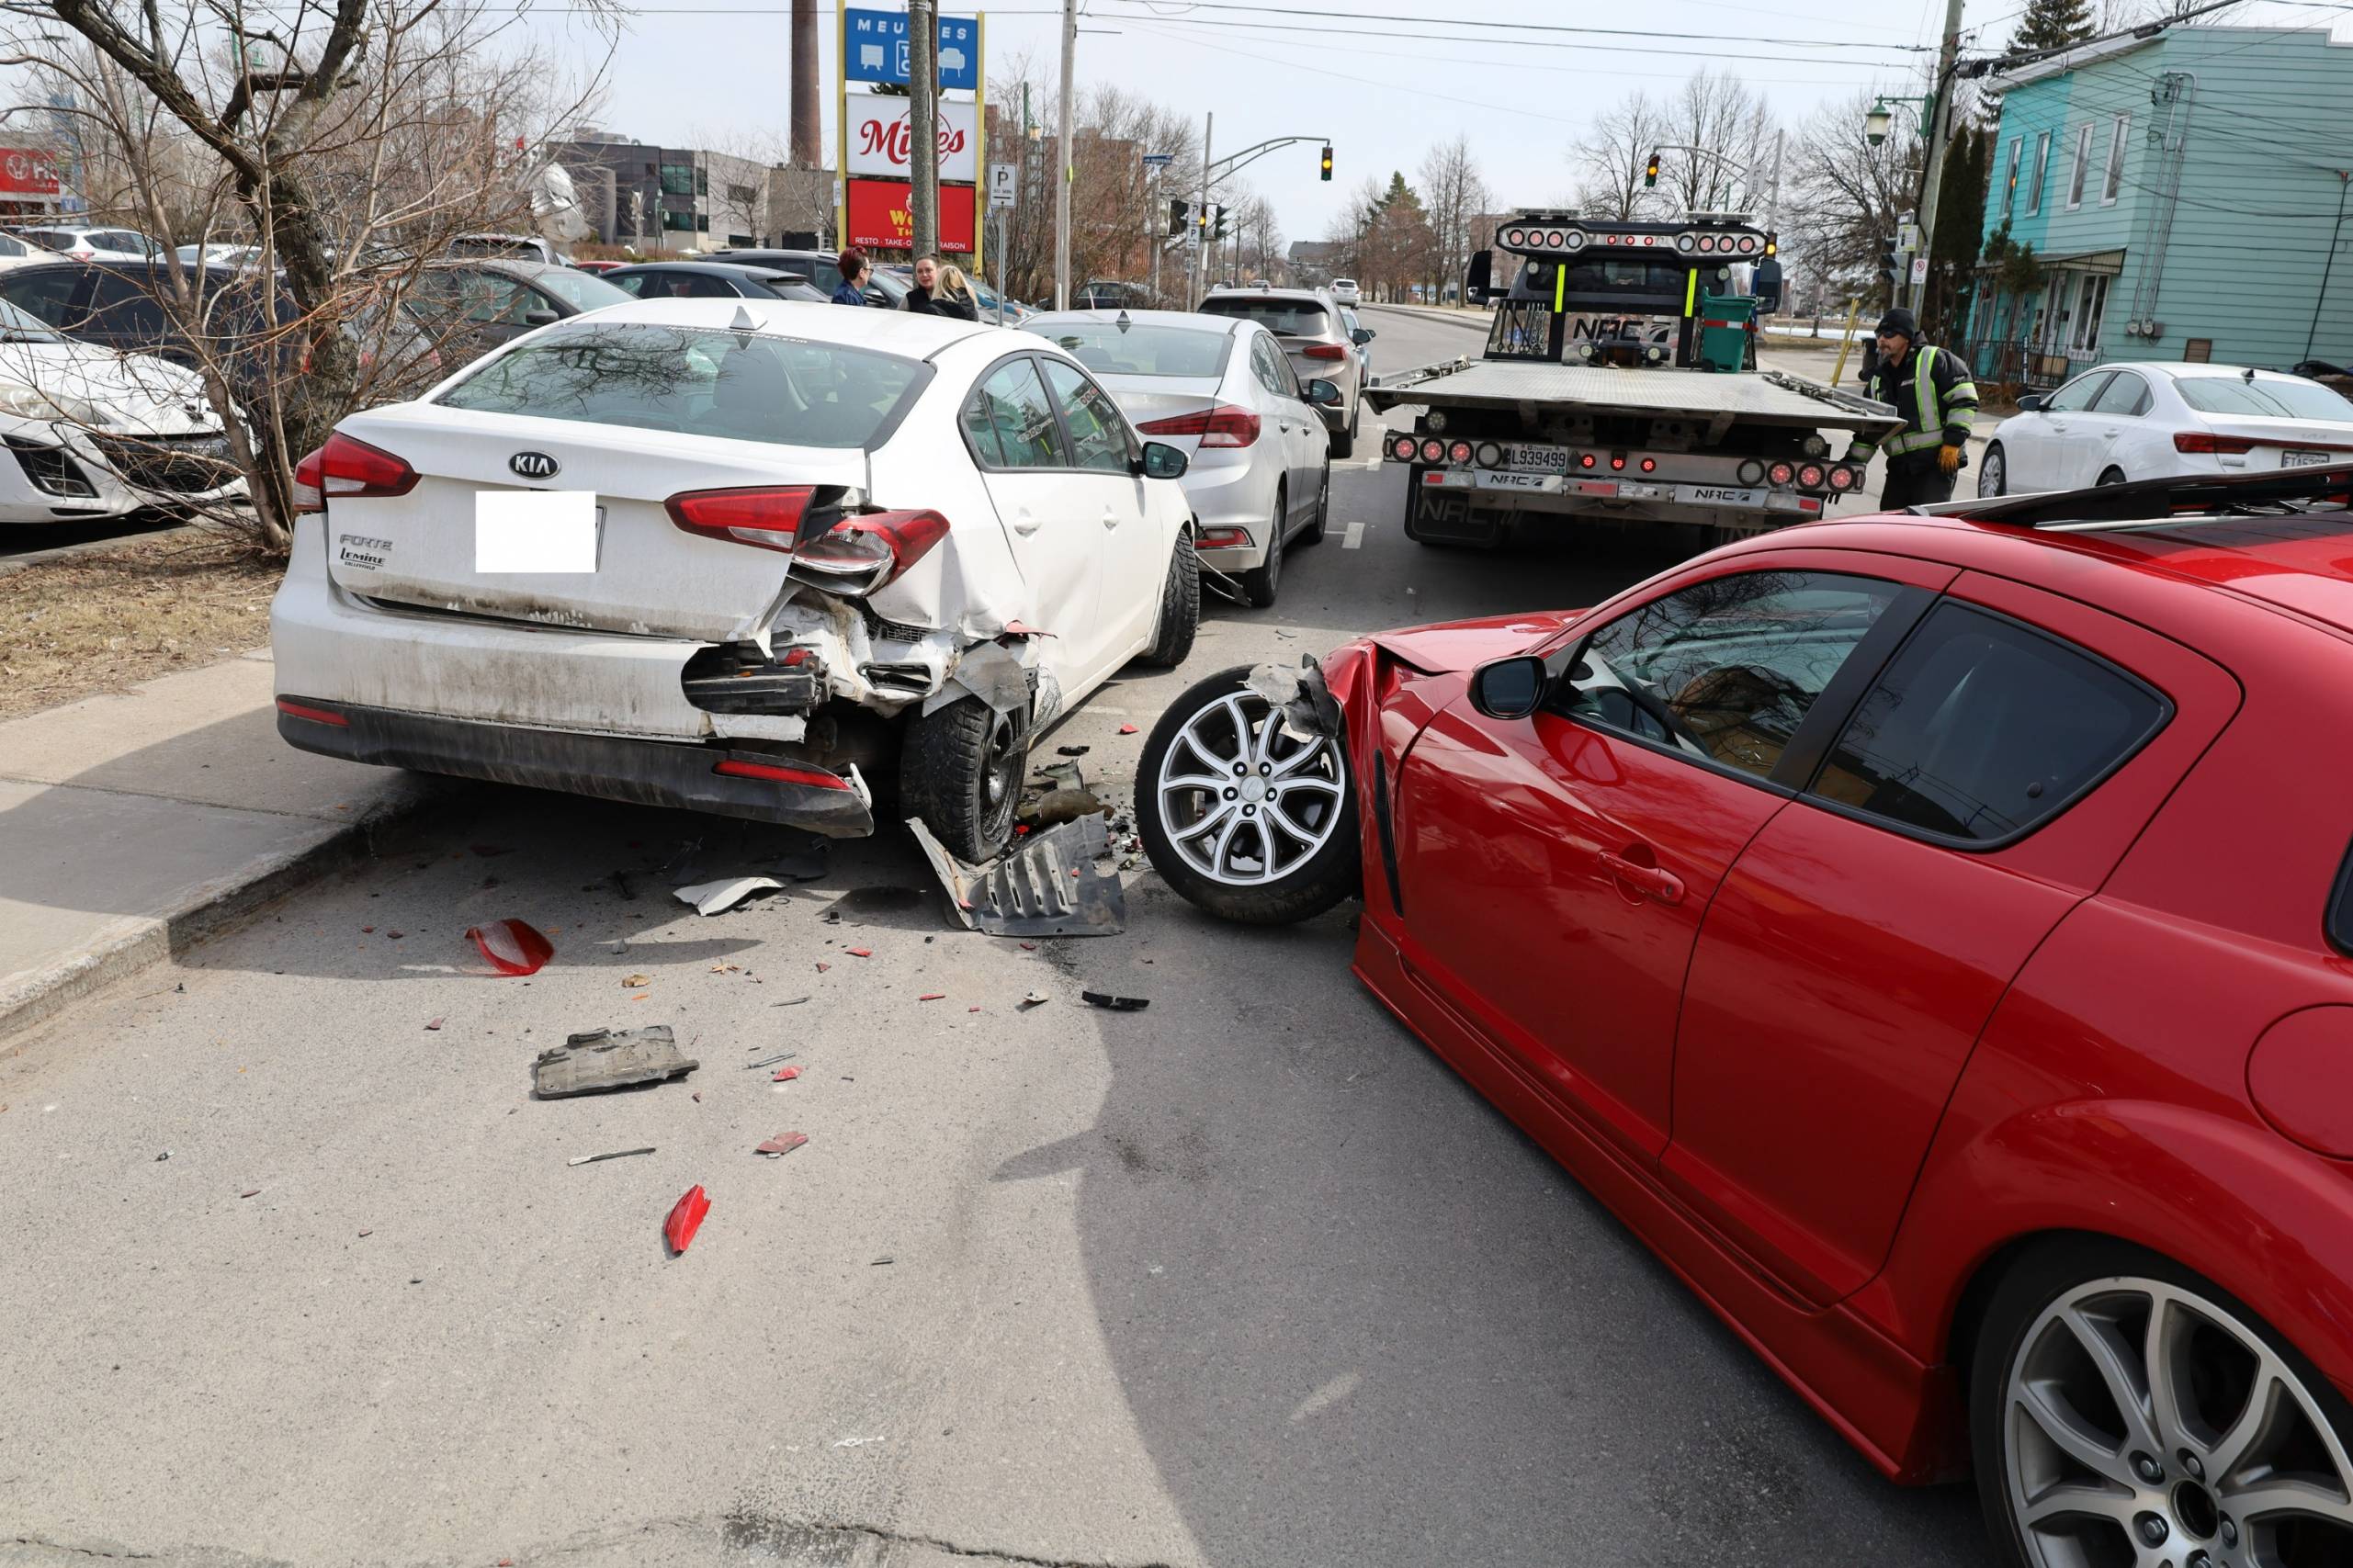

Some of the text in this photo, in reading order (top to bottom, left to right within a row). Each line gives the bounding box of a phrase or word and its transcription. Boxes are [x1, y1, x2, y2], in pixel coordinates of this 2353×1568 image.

[857, 18, 967, 39] MEUES
[860, 119, 965, 164] Mies
[998, 171, 1009, 186] P
[1573, 318, 1644, 342] NRC
[515, 456, 550, 474] KIA
[1511, 449, 1566, 468] L939499
[1490, 475, 1529, 485] NRC
[1695, 489, 1736, 500] NRC
[340, 534, 393, 551] FORTE
